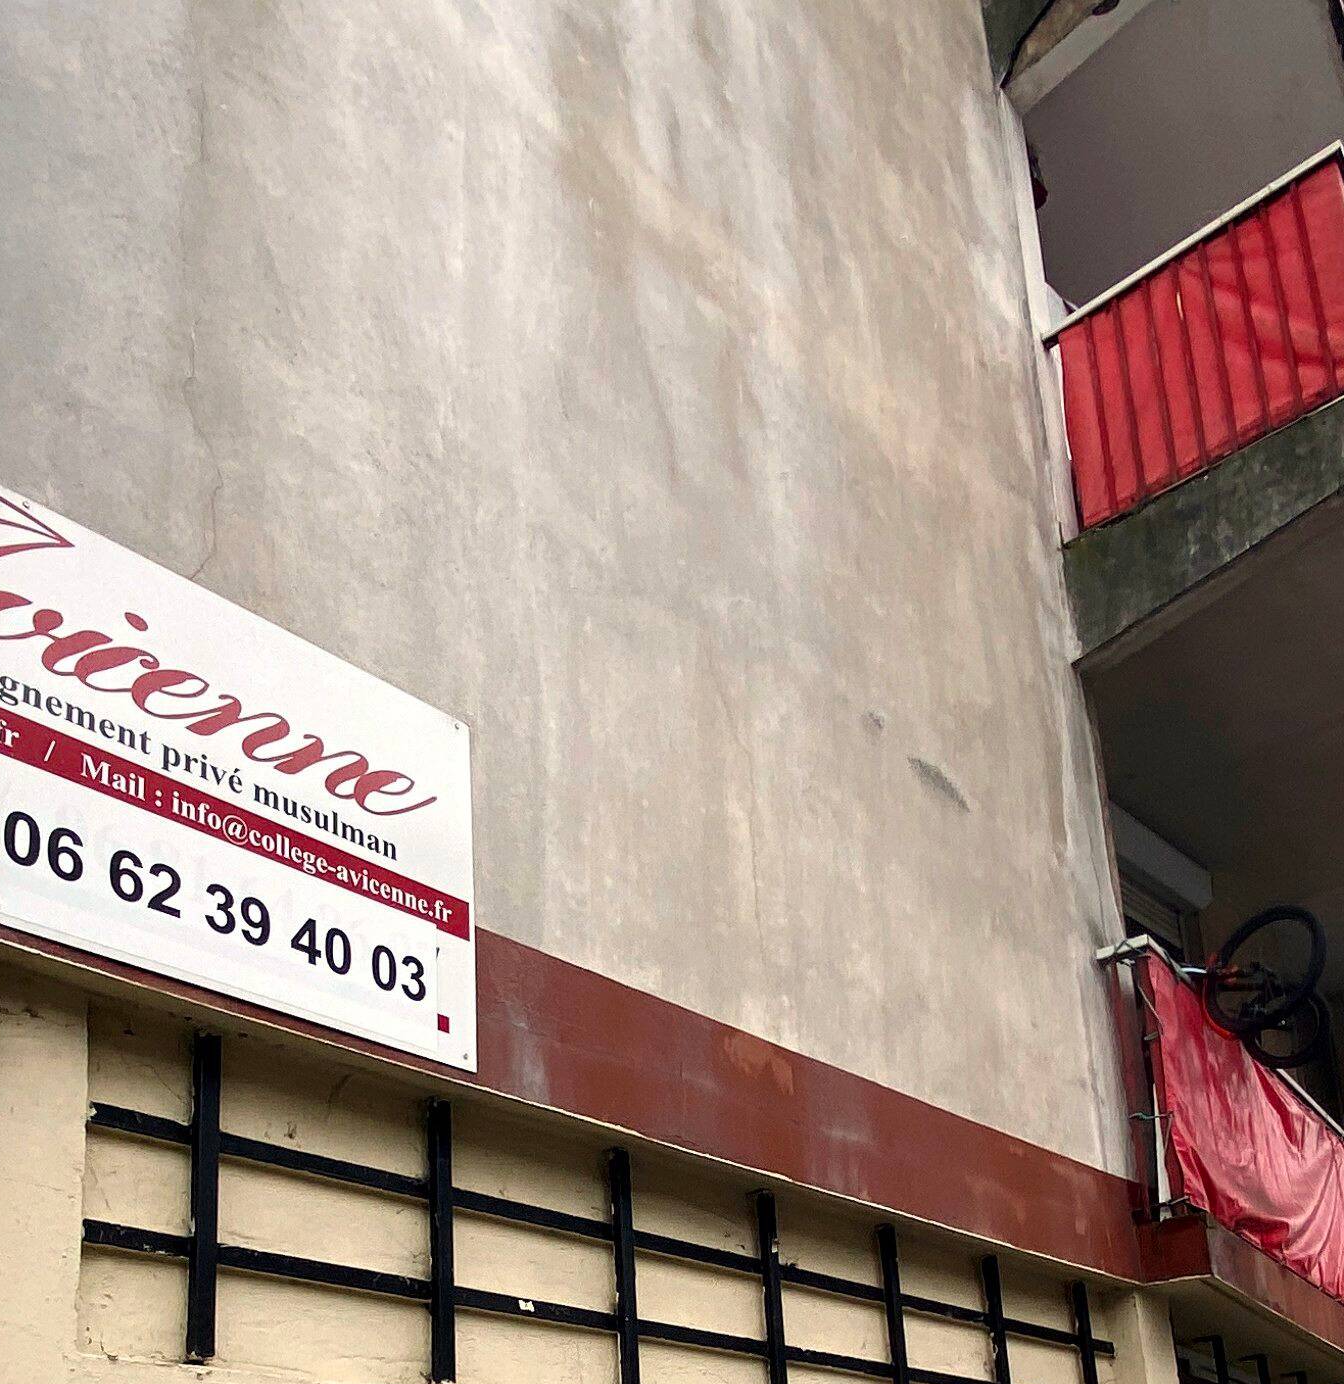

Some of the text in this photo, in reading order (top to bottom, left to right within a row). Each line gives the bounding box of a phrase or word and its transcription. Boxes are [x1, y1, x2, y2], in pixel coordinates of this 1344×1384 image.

[80, 751, 146, 802] Mail
[171, 788, 453, 924] info@college-avicenne.fr
[161, 744, 243, 794] privé
[253, 782, 397, 861] musulman
[3, 810, 84, 882] 06
[109, 849, 181, 919] 62
[204, 883, 271, 947] 39
[290, 917, 352, 975] 40
[371, 944, 426, 1002] 03
